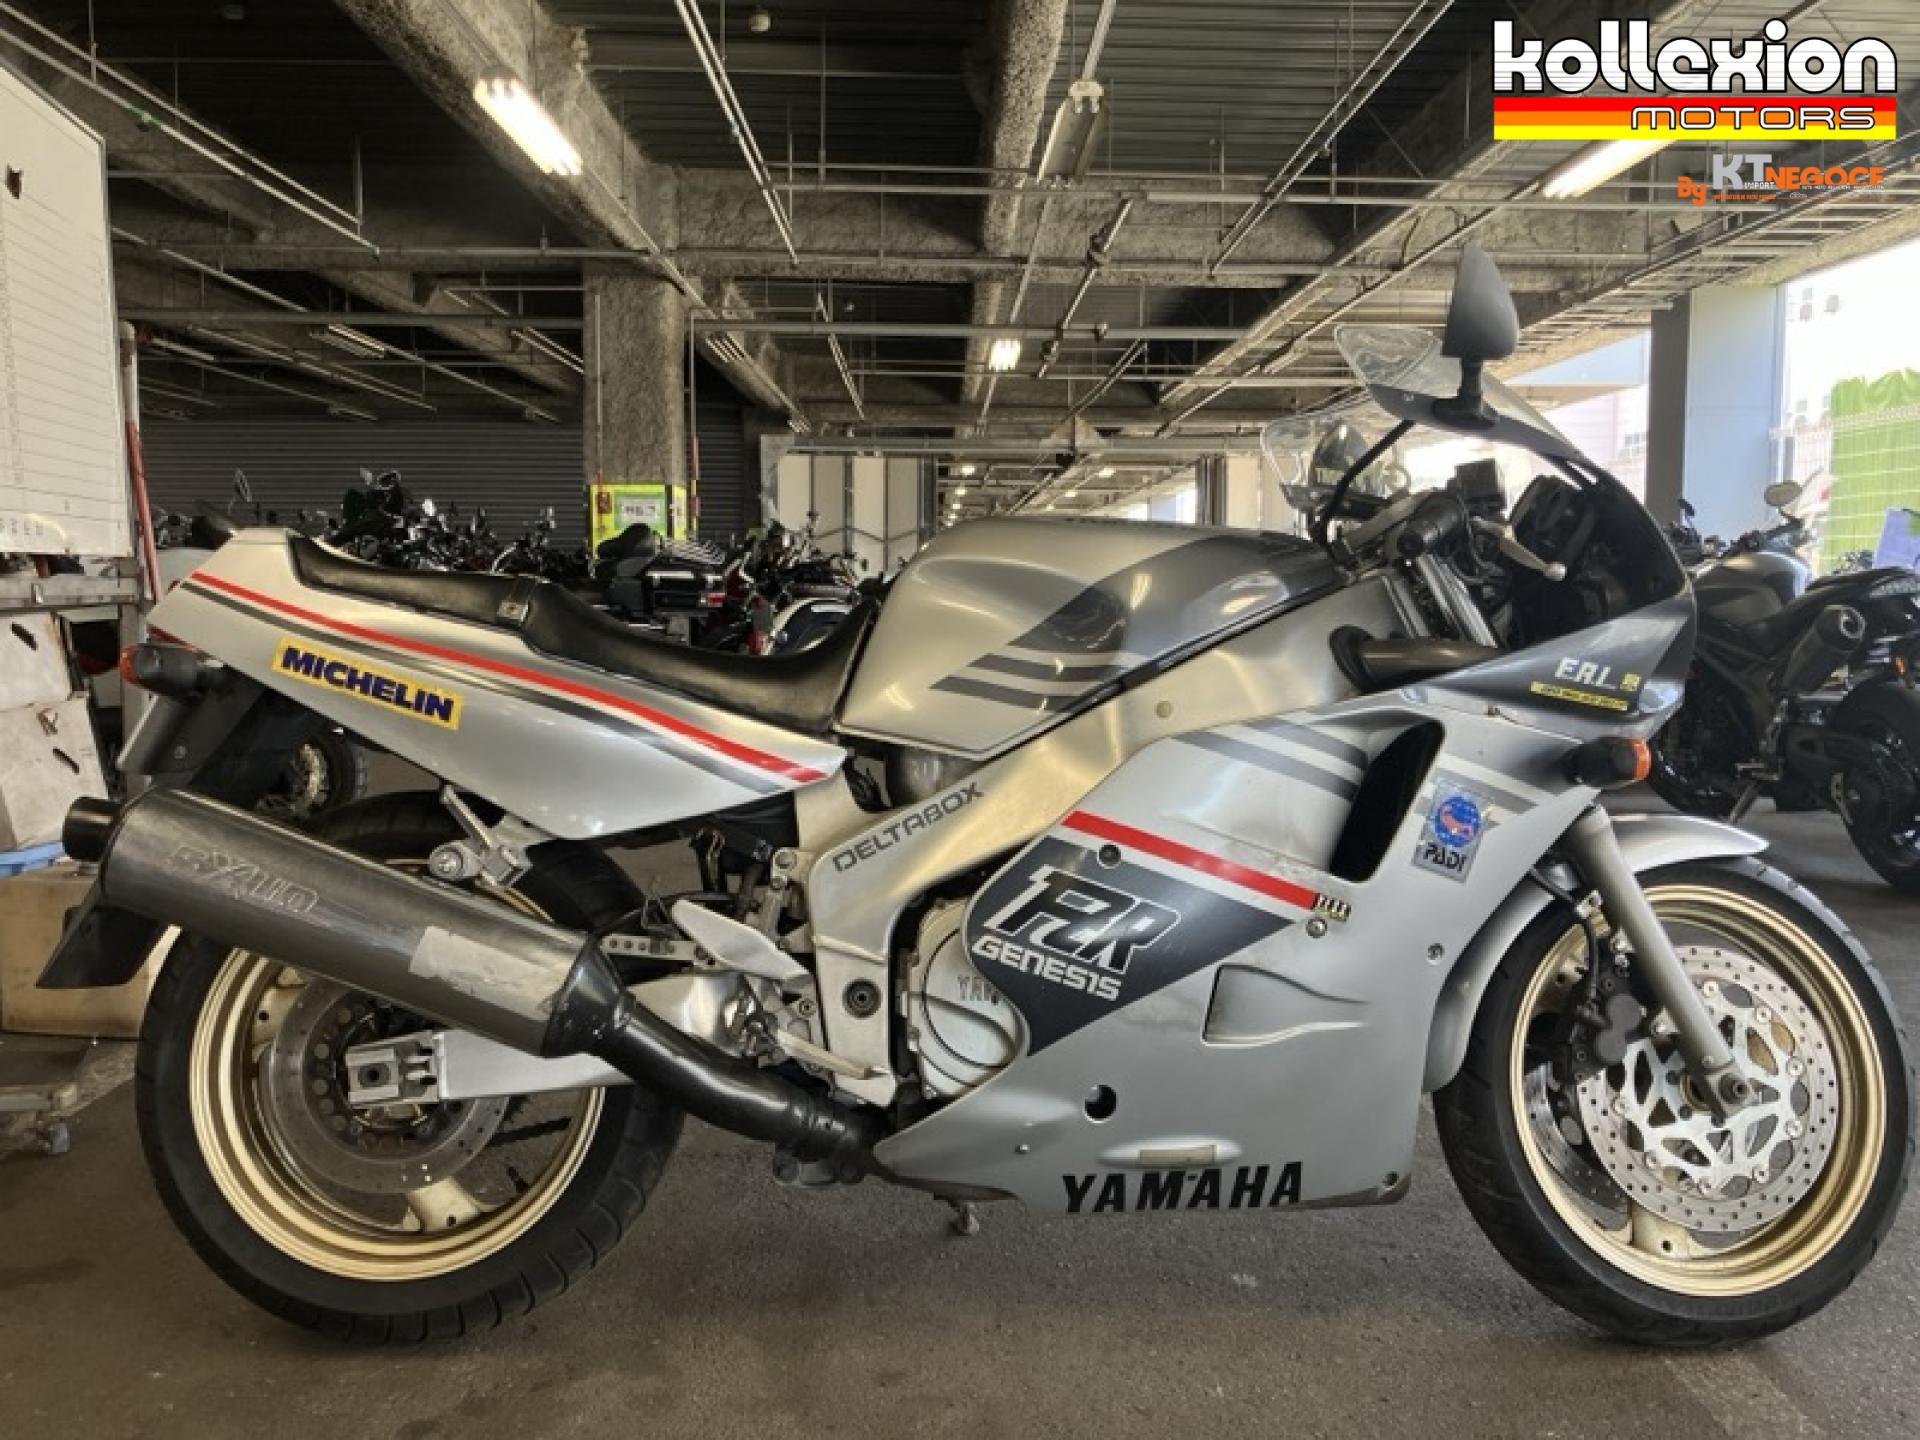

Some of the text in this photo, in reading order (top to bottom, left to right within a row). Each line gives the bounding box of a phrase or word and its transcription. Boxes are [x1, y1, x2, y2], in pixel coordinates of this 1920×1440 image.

[281, 645, 454, 721] MICHELIN
[833, 782, 984, 872] DELTABOX
[972, 935, 1122, 1001] GENESIS
[1062, 1161, 1302, 1213] YAMAHA
